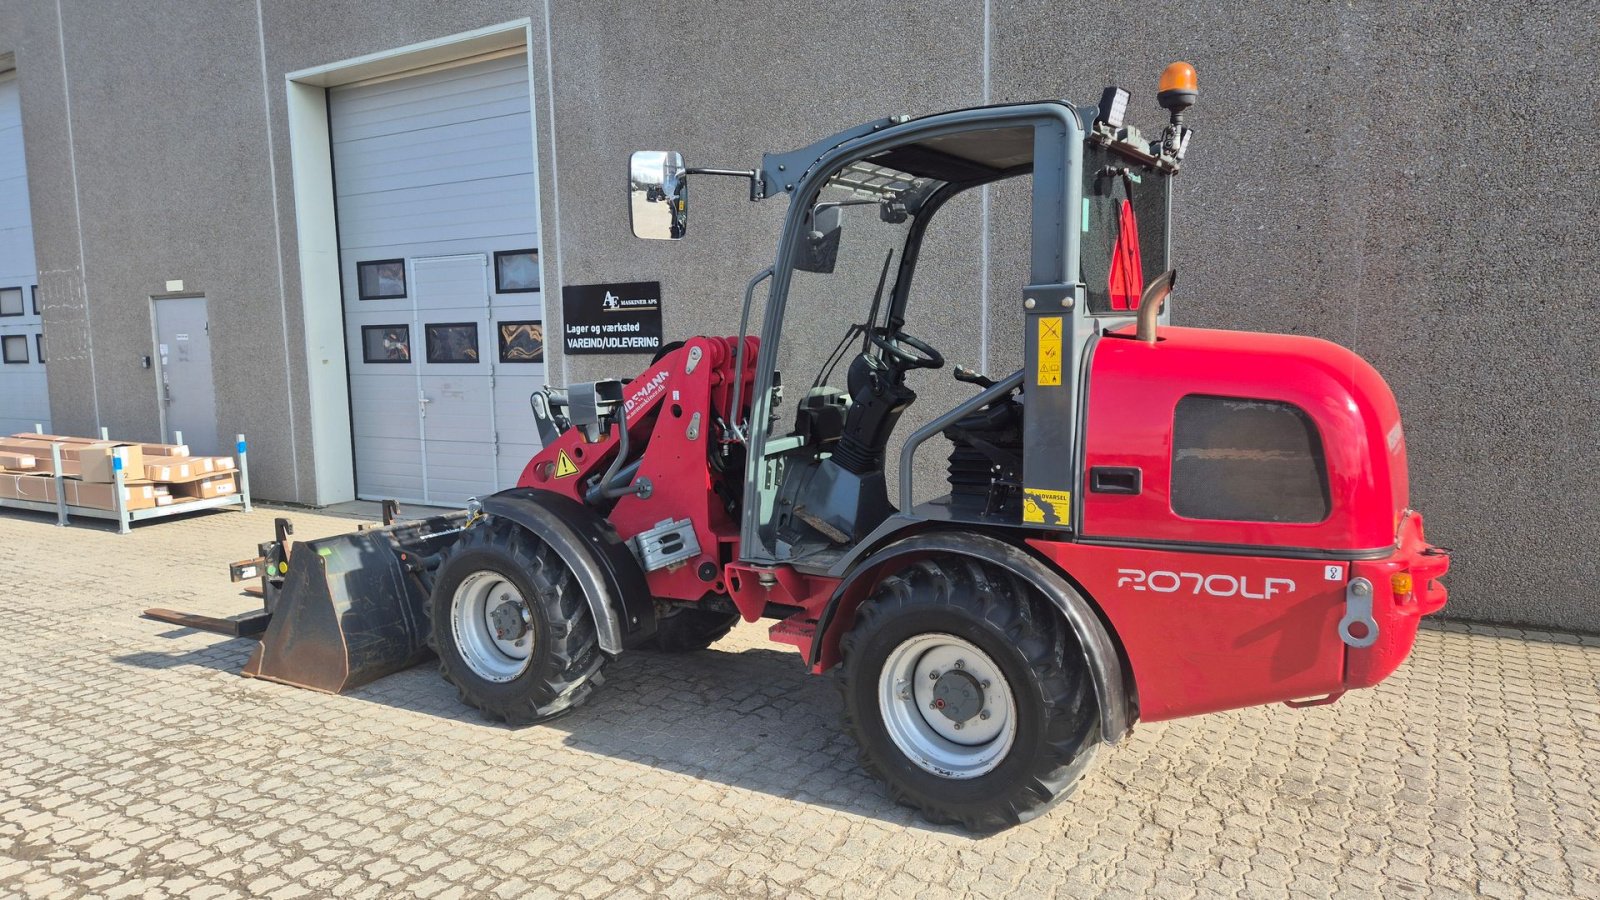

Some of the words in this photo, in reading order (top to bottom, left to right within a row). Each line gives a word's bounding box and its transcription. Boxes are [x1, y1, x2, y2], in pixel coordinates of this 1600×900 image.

[566, 324, 588, 335] Lager
[590, 326, 600, 334] og
[602, 322, 640, 332] værksted
[567, 336, 659, 349] VAREIND/UDLEVERING
